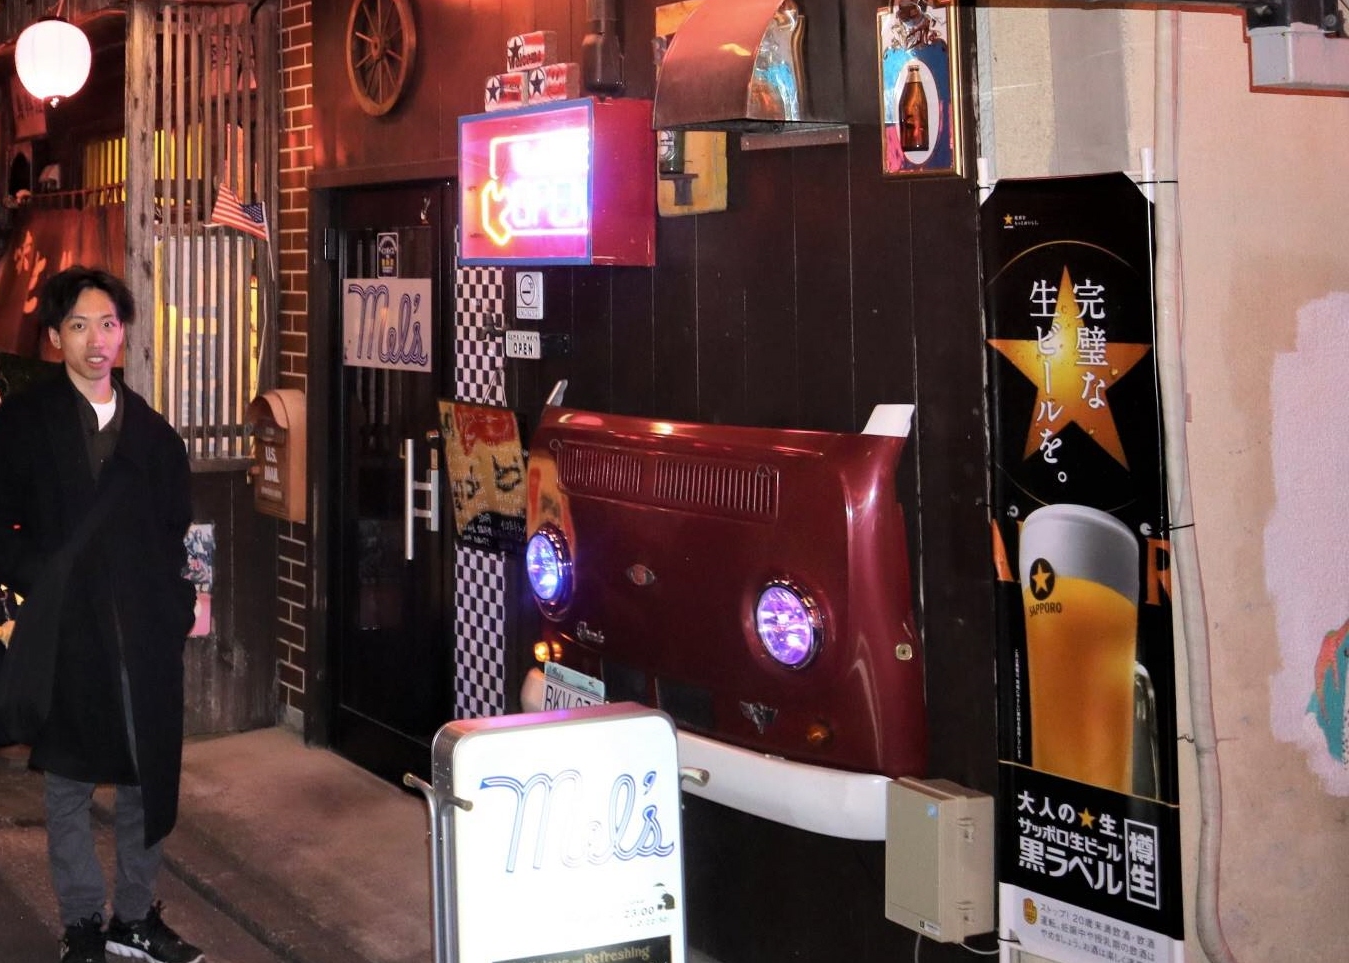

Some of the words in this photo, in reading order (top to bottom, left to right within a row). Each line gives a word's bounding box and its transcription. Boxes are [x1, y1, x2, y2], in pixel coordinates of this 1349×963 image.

[348, 284, 428, 366] Mel's
[513, 342, 533, 356] OPEN
[1073, 279, 1109, 410] 完璧な
[1029, 279, 1068, 483] 生ビールを。
[1029, 601, 1063, 617] SAPPORO
[480, 769, 675, 873] Mel's
[1018, 817, 1122, 863] サッポロ生ビール
[1018, 836, 1124, 896] 黒ラベル
[1128, 831, 1156, 898] 樽生
